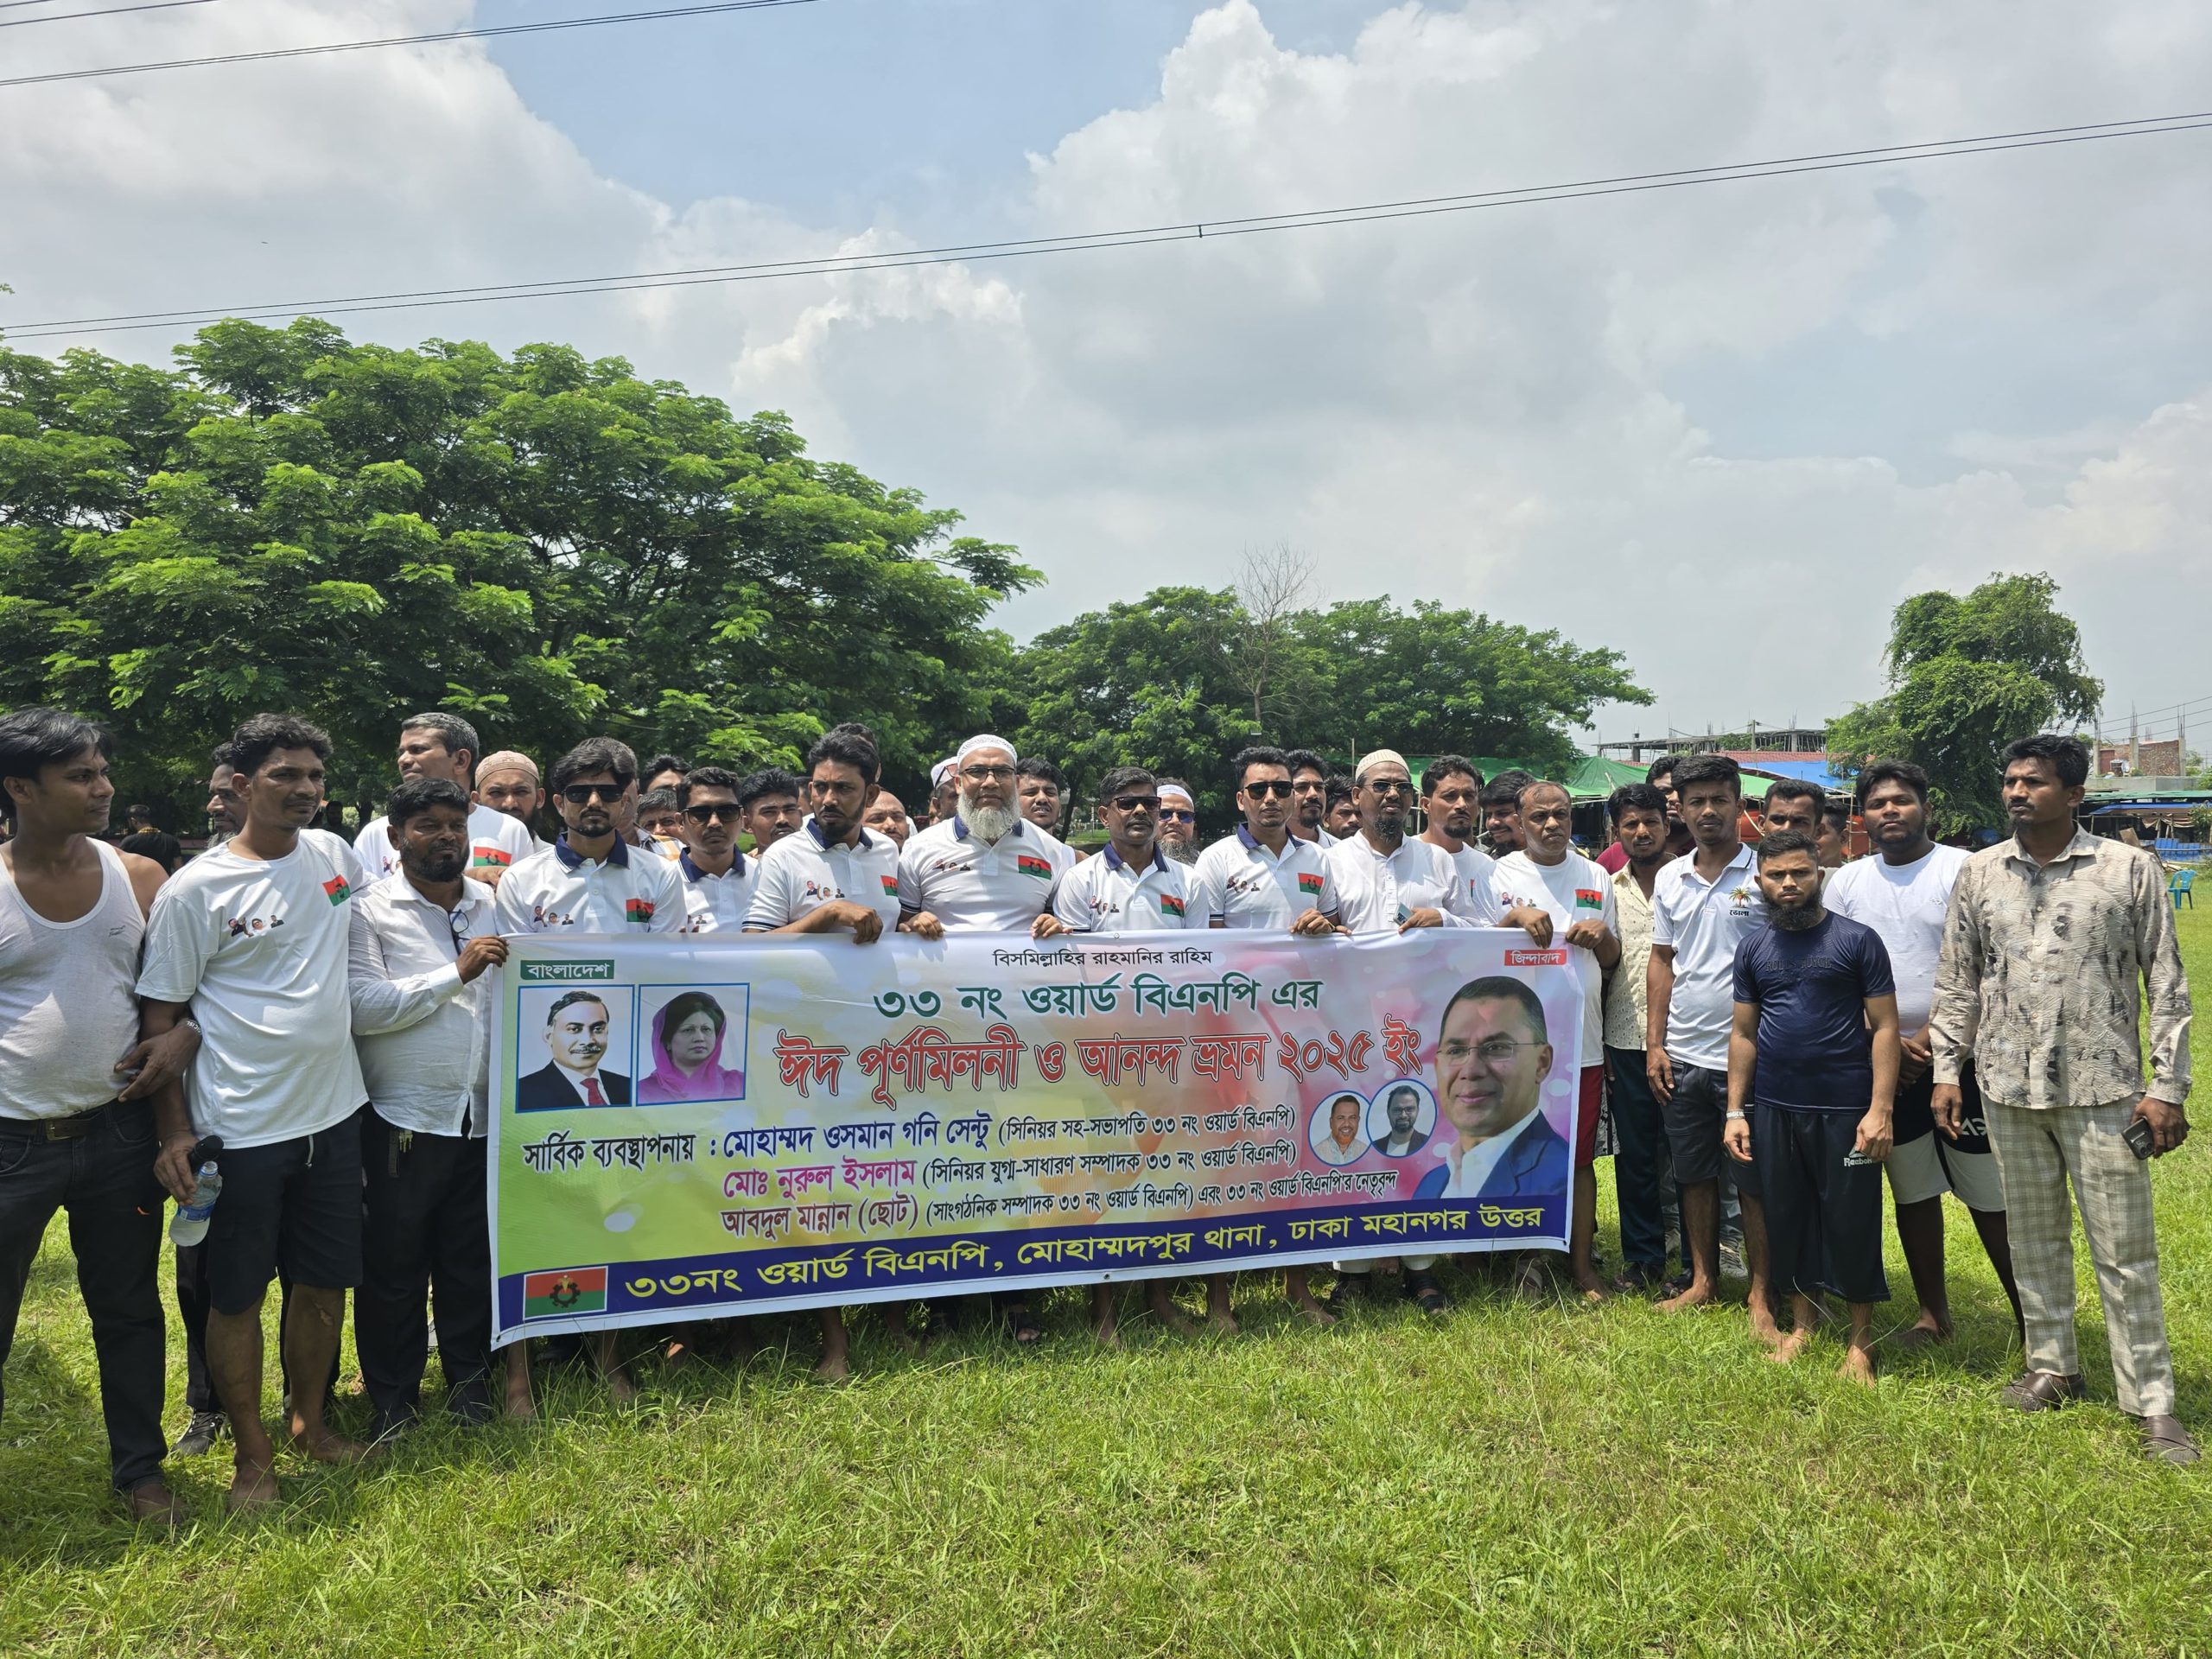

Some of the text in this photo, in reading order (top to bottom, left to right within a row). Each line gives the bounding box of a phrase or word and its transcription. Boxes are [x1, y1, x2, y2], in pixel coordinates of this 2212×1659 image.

[526, 963, 610, 979] বাংলাদেশ
[992, 947, 1213, 968] বিসমিল্লাহির রাহমানির রাহিম
[1510, 950, 1561, 964] জিন্দাবাদ
[873, 972, 1324, 1020] ৩৩ নং ওয়ার্ড বিএনপি এর
[773, 1014, 1424, 1111] ঈদ পূর্ণমিলনী ও আনন্দ ভ্রমন ২০২৫ ইং
[522, 1129, 587, 1173] সার্বিক
[722, 1126, 817, 1158] মোহাম্মদ
[823, 1121, 896, 1150] ওসমান
[902, 1111, 942, 1147] গনি
[946, 1109, 993, 1152] সেন্টু
[1061, 1111, 1147, 1139] সহ-সভাপতি
[1151, 1116, 1176, 1134] ৩৩
[1180, 1115, 1198, 1135] নং
[1242, 1104, 1296, 1133] বিএনপি)
[723, 1168, 768, 1198] মোঃ
[776, 1165, 836, 1200] নুরুল
[842, 1155, 918, 1192] ইসলাম
[1079, 1153, 1141, 1174] সম্পাদক
[1146, 1154, 1171, 1170] ৩৩
[1176, 1150, 1196, 1172] নং
[1241, 1139, 1298, 1167] বিএনপি)
[720, 1208, 791, 1239] আবদুল
[796, 1202, 853, 1234] মান্নান
[857, 1192, 919, 1234] (ছোট)
[925, 1193, 997, 1227] (সাংগঠনিক
[1001, 1194, 1055, 1217] সম্পাদক
[1058, 1194, 1080, 1211] ৩৩
[1085, 1192, 1100, 1211] নং
[1142, 1182, 1194, 1211] বিএনপি)
[1198, 1185, 1222, 1205] এবং
[1226, 1185, 1246, 1200] ৩৩
[1250, 1181, 1263, 1200] নং
[625, 1268, 743, 1298] ৩৩নং
[756, 1248, 855, 1285] ওয়ার্ড
[1016, 1231, 1195, 1265] মোহাম্মদপুর
[1287, 1216, 1354, 1242] ঢাকা
[1359, 1209, 1471, 1236] মহানগর
[1476, 1203, 1546, 1229] উত্তর
